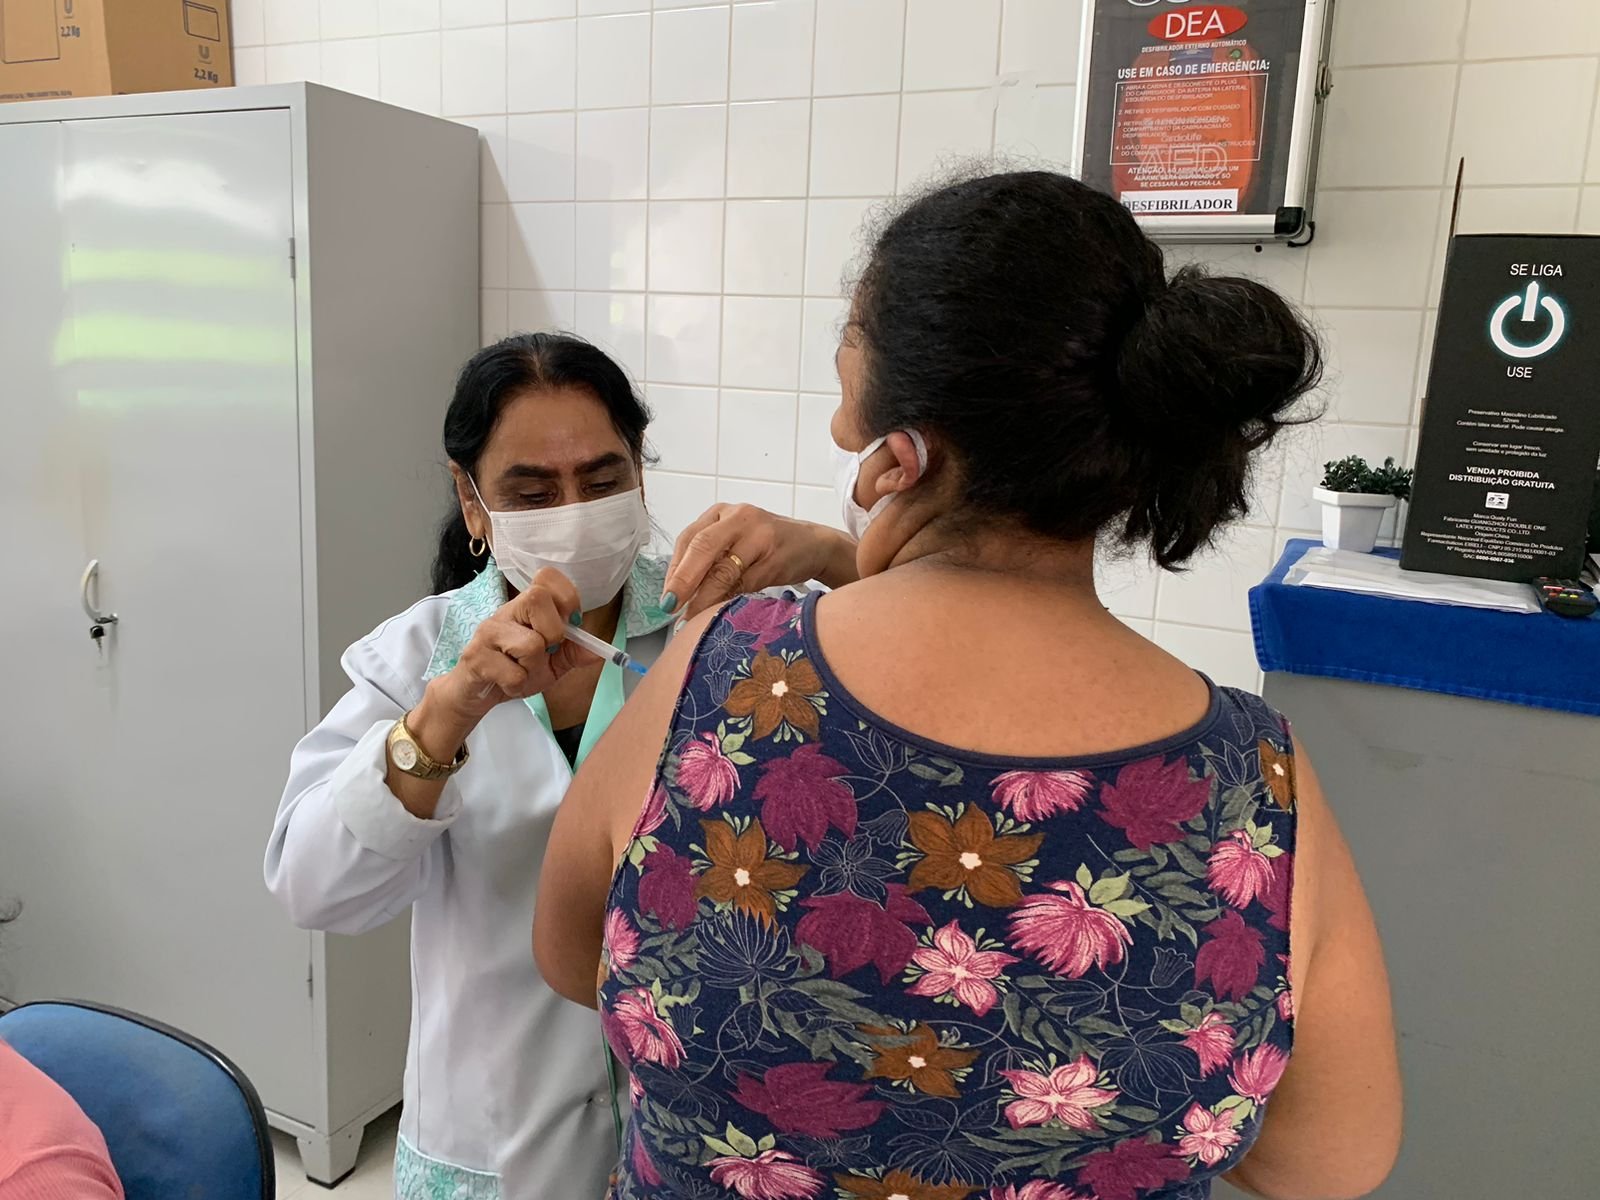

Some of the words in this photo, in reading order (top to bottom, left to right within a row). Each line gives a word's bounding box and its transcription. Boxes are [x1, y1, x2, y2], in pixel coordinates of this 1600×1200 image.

[1165, 9, 1226, 39] DEA
[1141, 44, 1184, 53] DESFIBRILADOR
[1185, 42, 1210, 50] EXTERNO
[1210, 39, 1247, 48] AUTOMÁTICO
[1117, 69, 1137, 79] USE
[1139, 68, 1154, 78] EM
[1156, 66, 1182, 77] CASO
[1184, 65, 1198, 75] DE
[1200, 59, 1270, 74] EMERGÊNCIA:
[1509, 264, 1529, 276] SE
[1531, 264, 1563, 277] LIGA
[1506, 366, 1533, 379] USE
[1472, 440, 1499, 448] Conservar
[1466, 466, 1496, 476] VENDA
[1497, 468, 1540, 479] PROIBIDA
[1448, 474, 1510, 486] DISTRIBUIÇÃO
[1511, 479, 1556, 490] GRATUITA
[1470, 519, 1508, 527] GUANGZHOU
[1508, 522, 1533, 530] DOUBLE
[1474, 525, 1506, 534] PRODUCTS
[1539, 543, 1564, 551] Produtos
